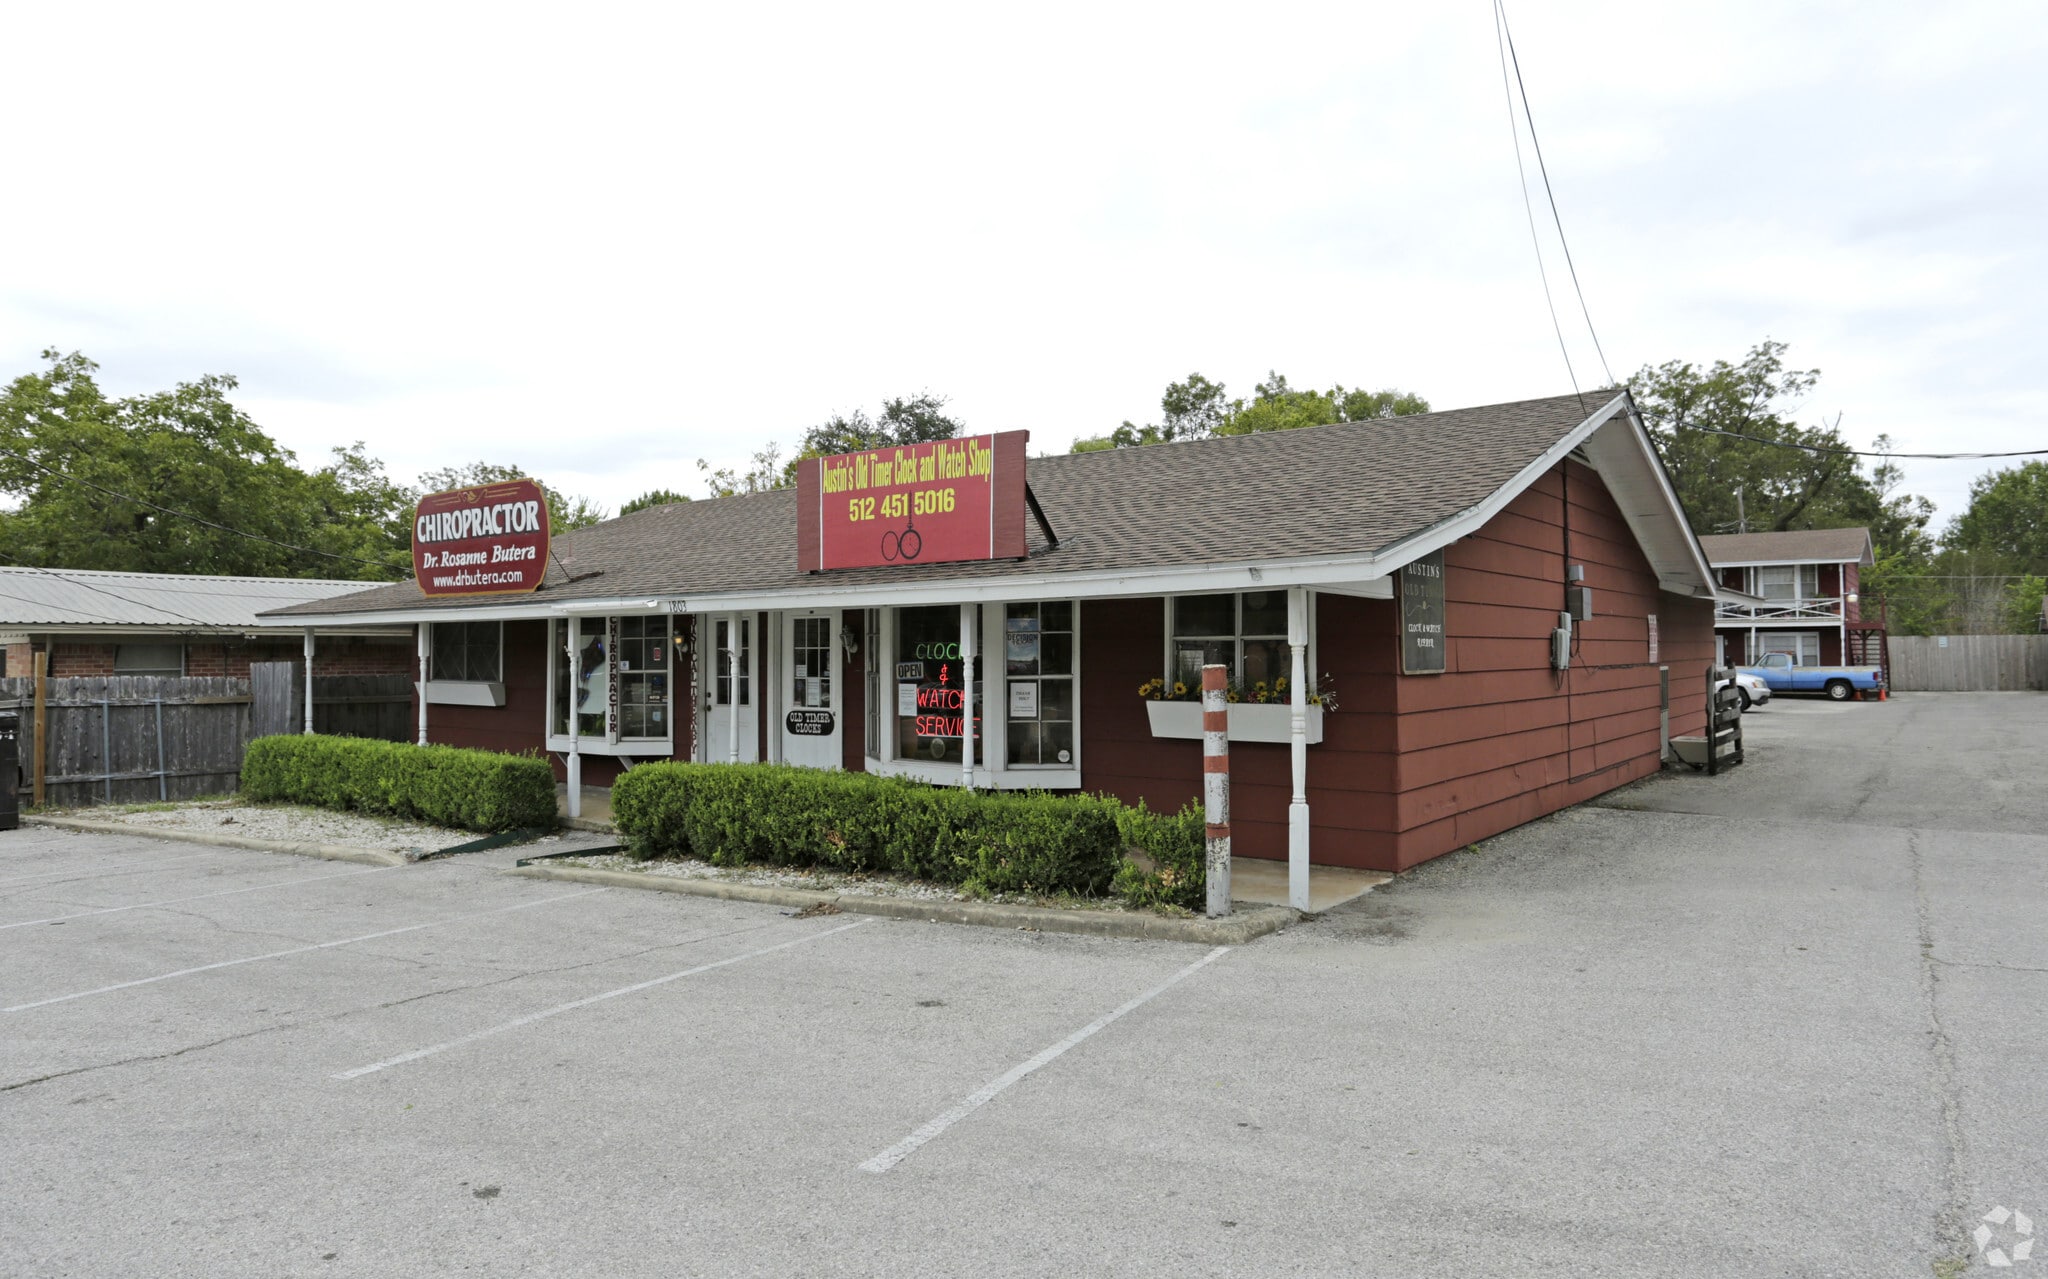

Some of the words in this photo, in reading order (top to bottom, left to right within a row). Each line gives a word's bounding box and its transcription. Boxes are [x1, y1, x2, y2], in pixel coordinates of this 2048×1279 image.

[823, 456, 854, 494] Austin's
[856, 454, 869, 490] Old
[870, 453, 893, 488] Timer
[895, 448, 918, 485] Clock
[920, 444, 936, 482] and
[938, 441, 966, 480] Watch
[968, 438, 991, 483] Shop
[849, 496, 875, 522] 512
[881, 493, 909, 518] 451
[914, 487, 955, 515] 5016
[416, 500, 540, 543] CHIROPRACTOR
[423, 552, 439, 569] Dr.
[440, 551, 488, 568] Rosanne
[491, 544, 536, 563] Butera
[433, 569, 523, 587] www.drbutera.com
[1408, 562, 1440, 578] AUSTIN'S
[668, 600, 687, 613] 1803
[609, 616, 617, 733] CHIROPRACTOR
[898, 664, 922, 678] OPEN
[789, 712, 803, 723] OLD
[805, 713, 831, 723] TIMER
[795, 723, 822, 734] CLOCKS
